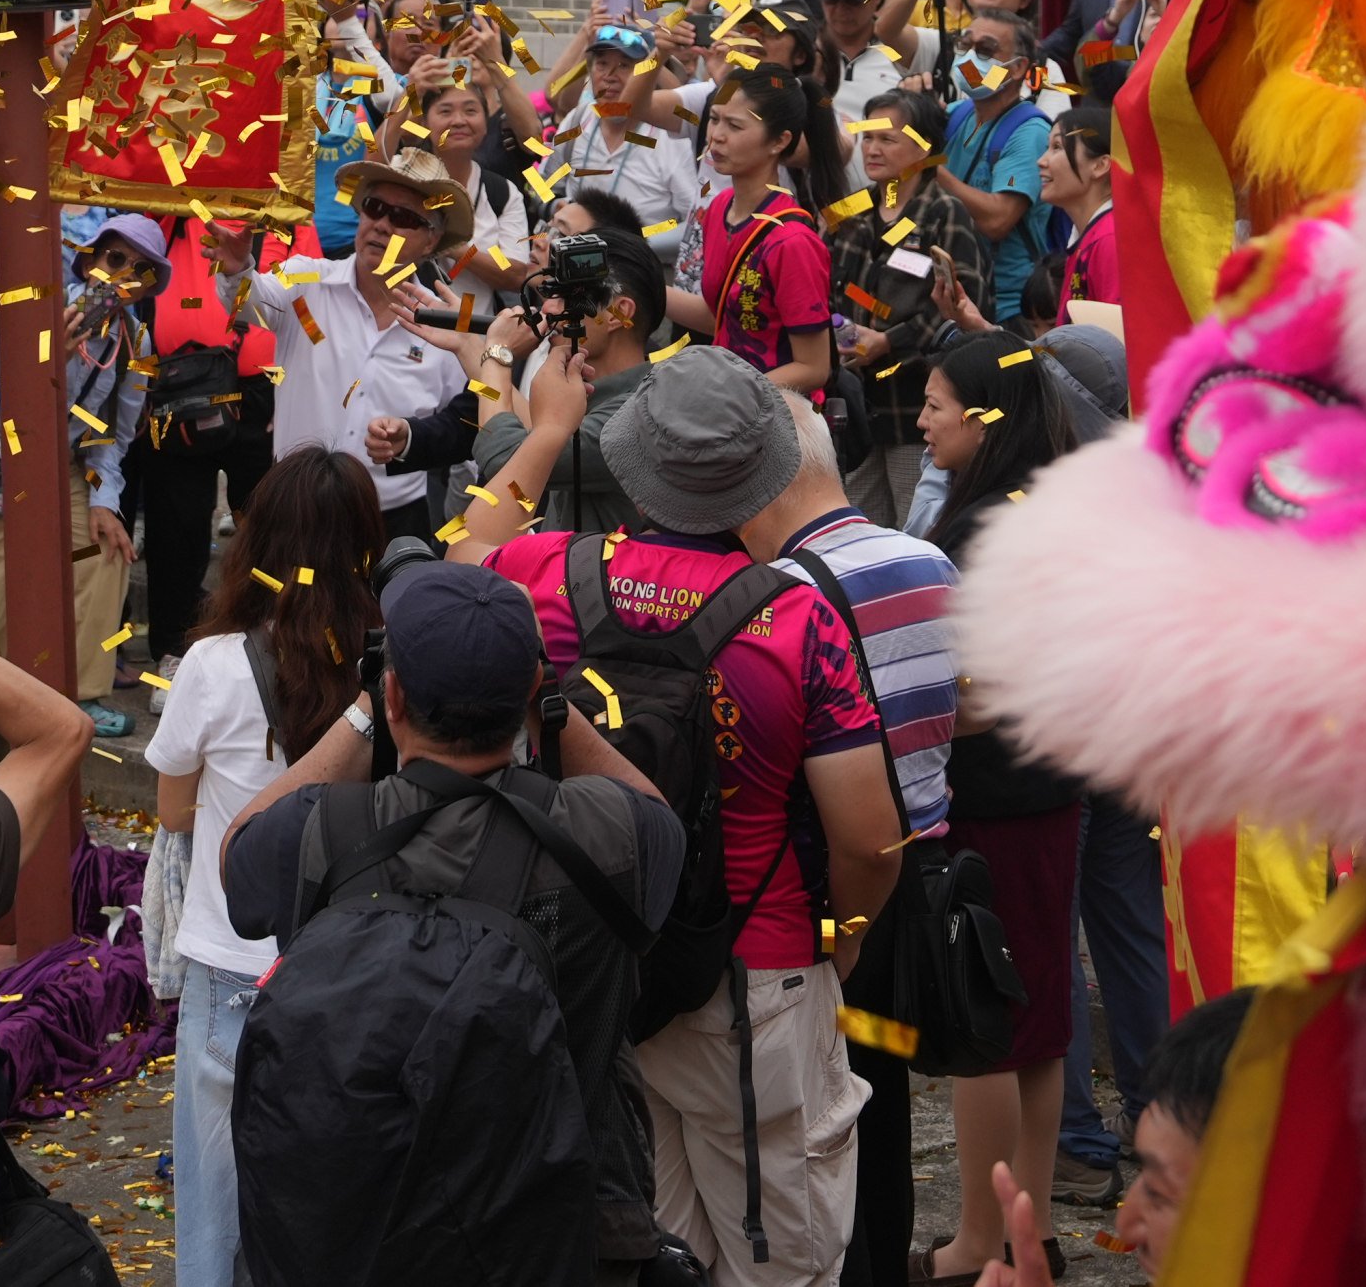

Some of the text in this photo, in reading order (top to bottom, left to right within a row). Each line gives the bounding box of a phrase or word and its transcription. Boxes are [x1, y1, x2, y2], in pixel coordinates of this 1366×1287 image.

[609, 576, 704, 608] KONG LION
[634, 602, 679, 621] SPORTS
